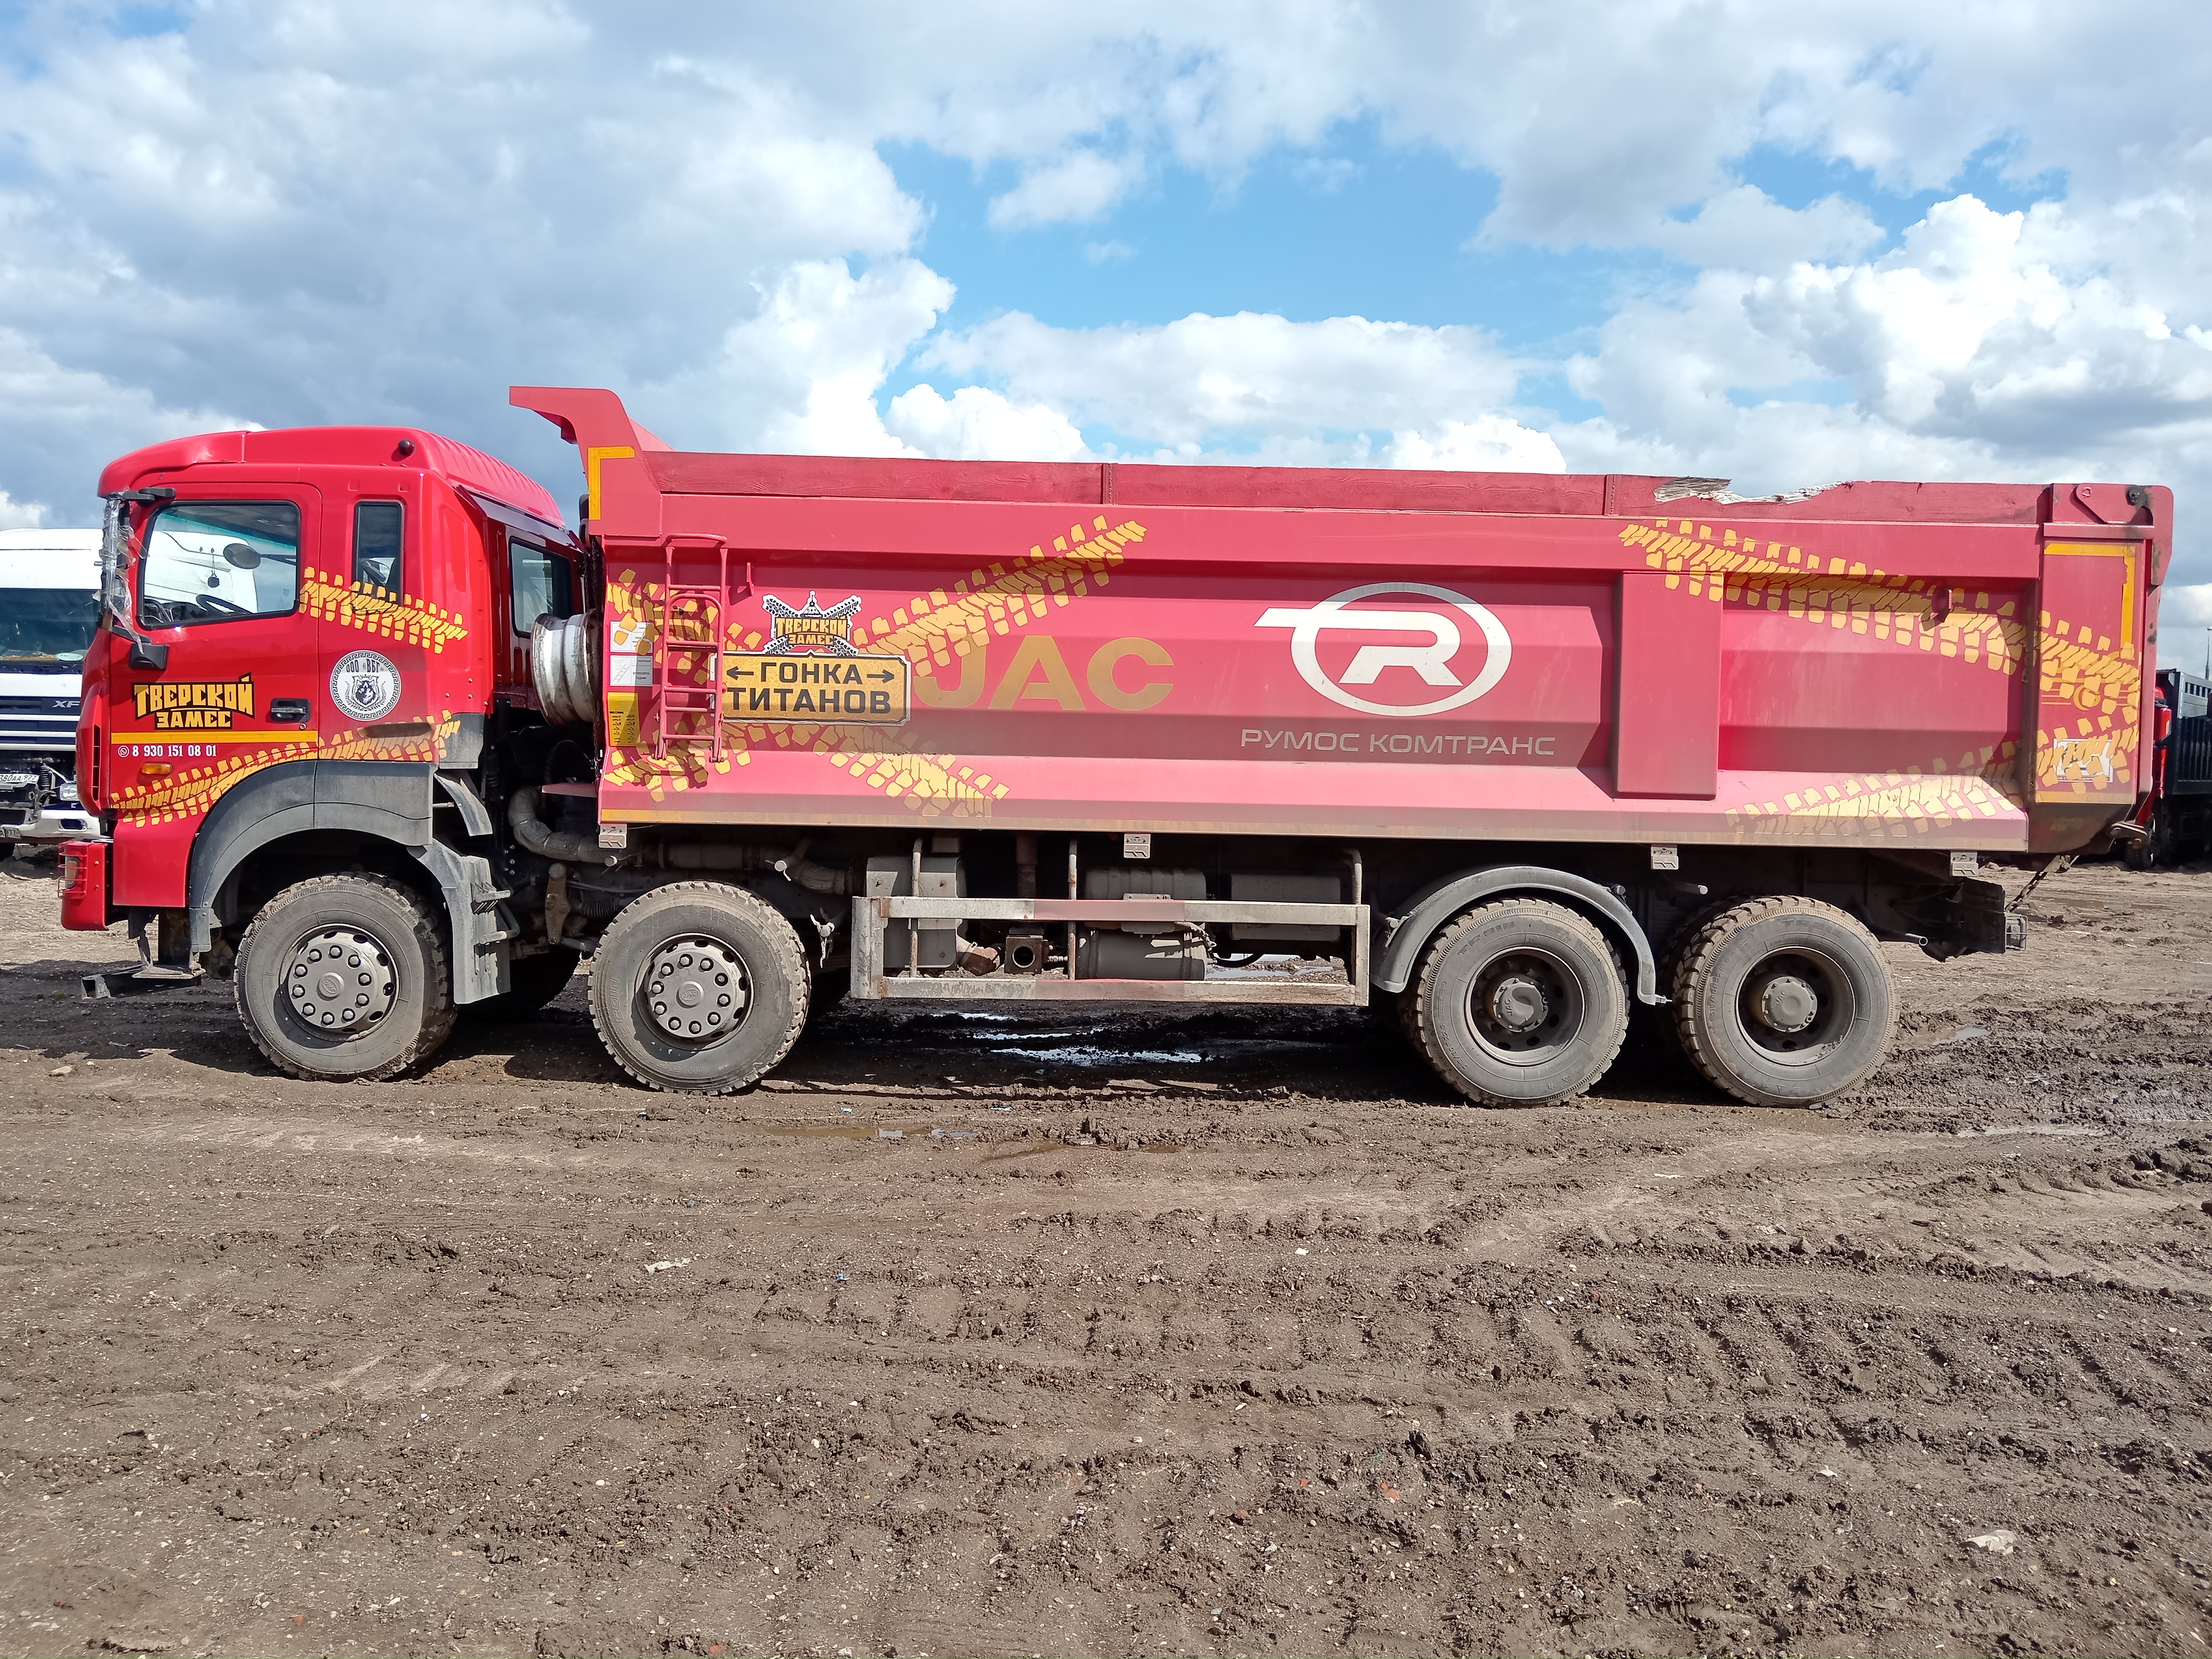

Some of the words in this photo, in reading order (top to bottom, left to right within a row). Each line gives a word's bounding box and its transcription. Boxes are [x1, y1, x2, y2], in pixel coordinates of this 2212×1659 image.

[776, 615, 847, 639] ТВЕРСКОЙ
[788, 634, 833, 645] ЗАМЕС
[346, 660, 359, 673] ООО
[760, 662, 863, 685] ГОНКА
[913, 634, 1174, 711] JAC
[52, 700, 81, 708] XF
[134, 676, 254, 717] ТВЕРСКОЙ
[726, 687, 891, 714] ТИТАНОВ
[156, 711, 231, 728] ЗАМЕС
[132, 745, 139, 757] 8
[144, 745, 163, 757] 930
[168, 745, 183, 757] 151
[188, 745, 201, 757] 08
[205, 745, 217, 757] 01
[1240, 729, 1360, 752] РУМОС
[1369, 734, 1556, 756] КОМТРАНС
